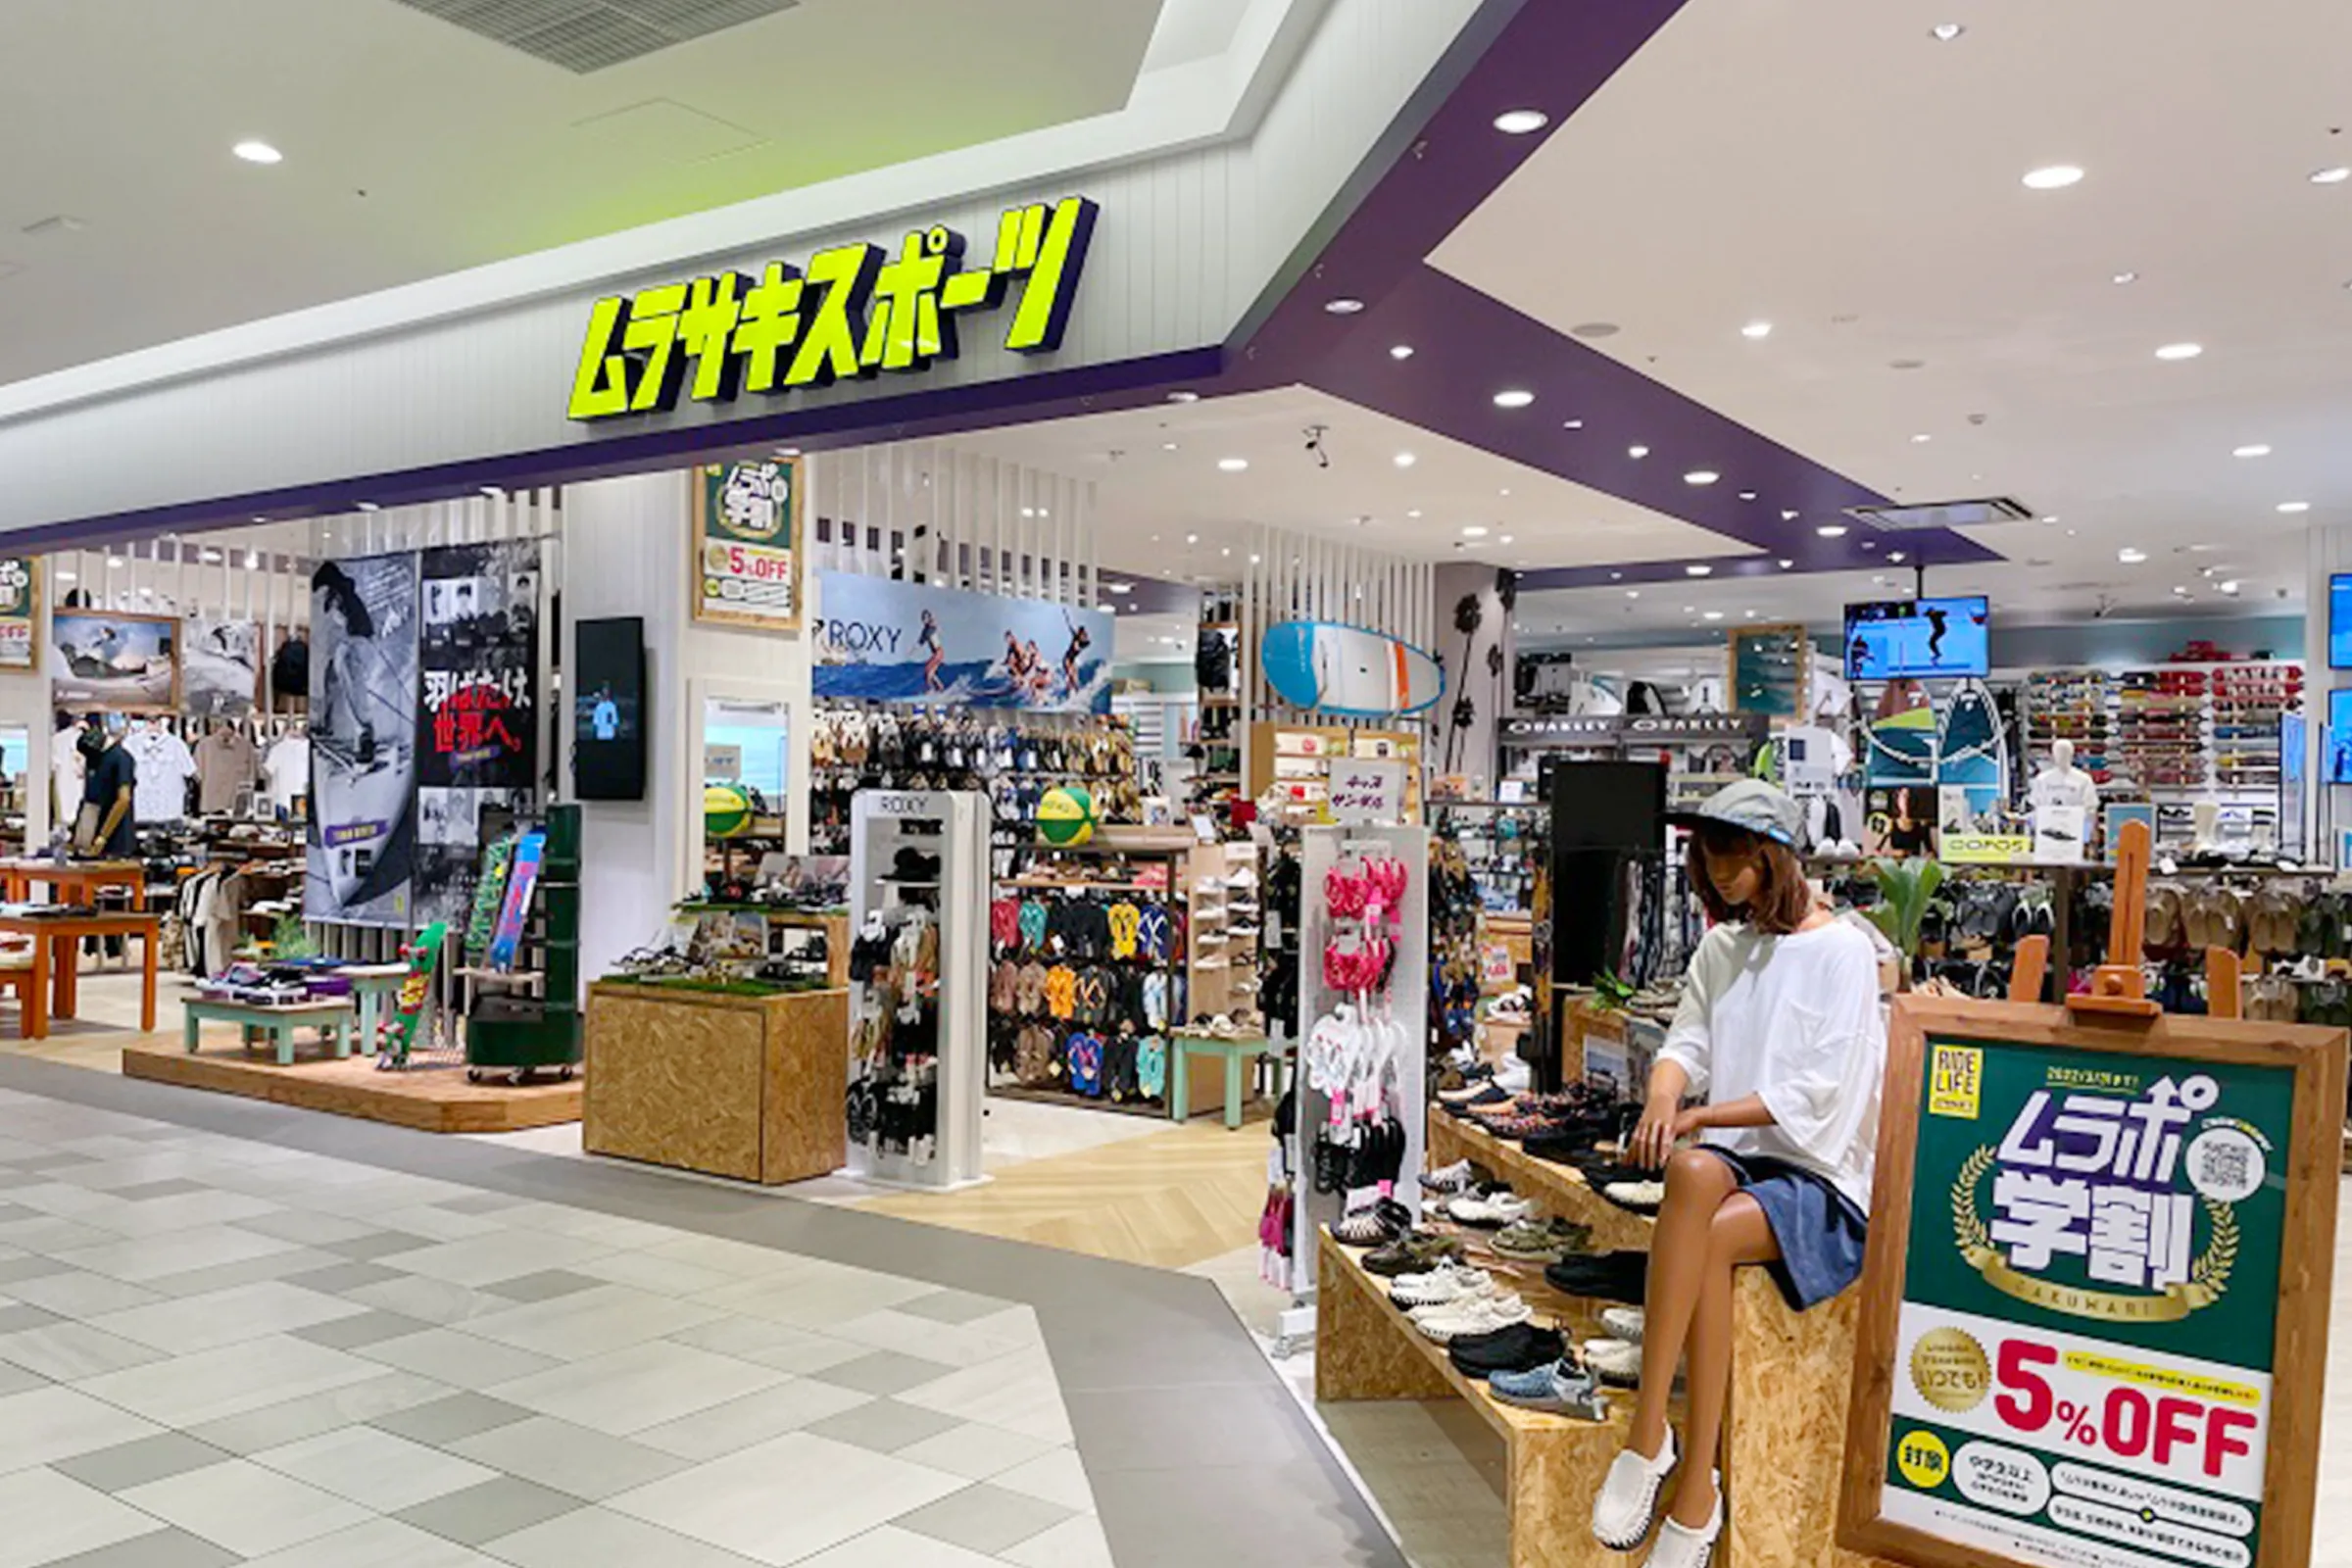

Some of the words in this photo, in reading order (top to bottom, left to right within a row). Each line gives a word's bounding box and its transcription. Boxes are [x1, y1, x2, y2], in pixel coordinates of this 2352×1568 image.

[567, 197, 1096, 420] ムラサキスポーツ
[829, 619, 902, 654] ROXY
[882, 795, 930, 814] ROXY
[1936, 1071, 1975, 1096] LIFE
[1996, 1074, 2221, 1184] ムラポ
[1989, 1168, 2194, 1293] 学割
